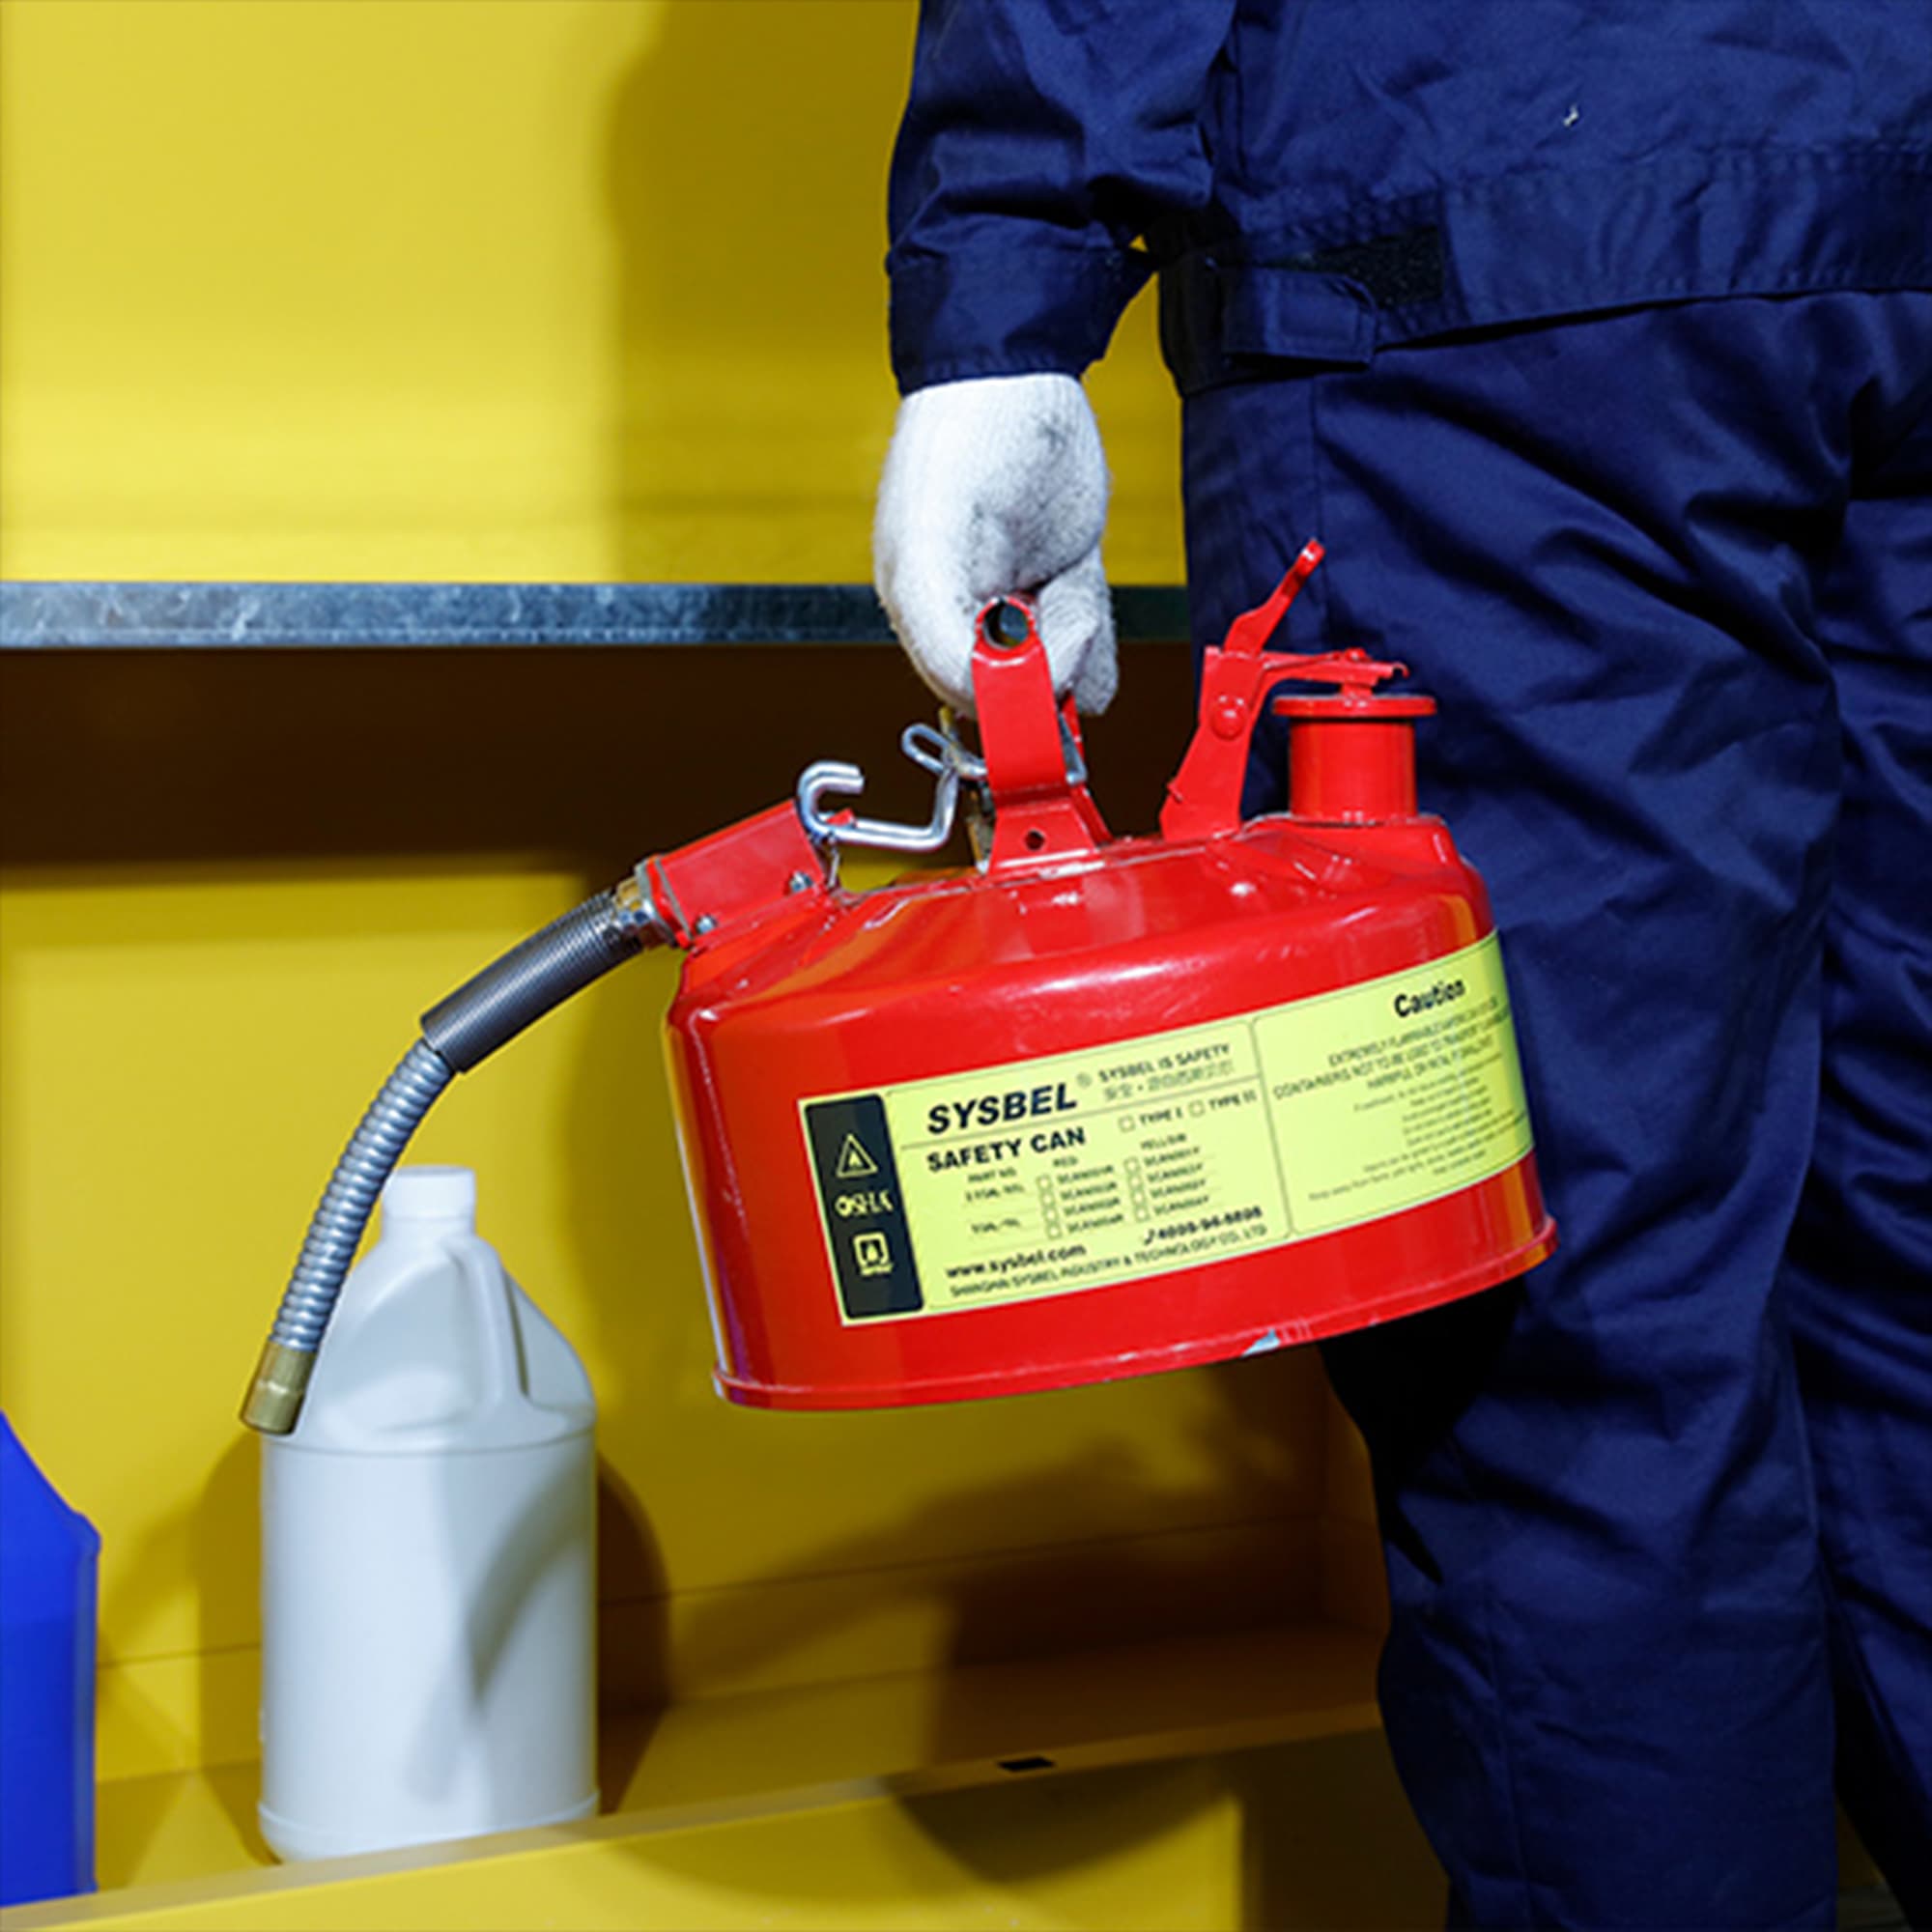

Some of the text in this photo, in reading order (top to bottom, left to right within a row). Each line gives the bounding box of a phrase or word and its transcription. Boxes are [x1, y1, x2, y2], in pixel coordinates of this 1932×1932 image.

[1394, 979, 1465, 1017] Caution
[1098, 1061, 1154, 1082] SYSBEL
[1158, 1056, 1173, 1068] IS
[1176, 1043, 1230, 1065] SAFETY
[927, 1082, 1077, 1135] SYSBEL
[1140, 1108, 1171, 1125] TYPE
[1209, 1094, 1240, 1110] TYPE
[926, 1126, 1086, 1173] SAFETY CAN
[946, 1244, 1087, 1277] www.sysbel.com
[1011, 1268, 1058, 1287] SYSBEL
[1134, 1236, 1216, 1263] TECHNOLOGY
